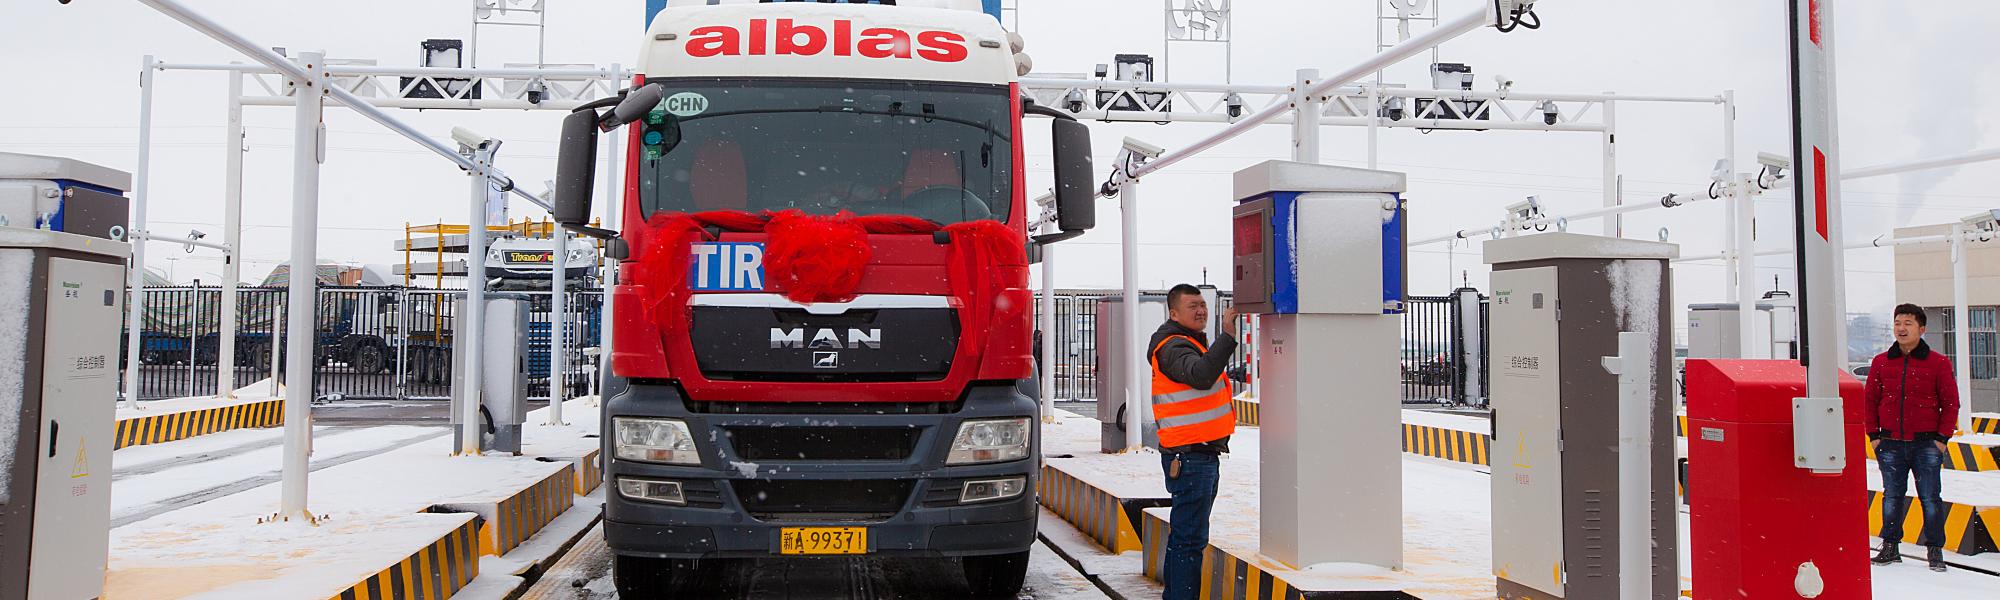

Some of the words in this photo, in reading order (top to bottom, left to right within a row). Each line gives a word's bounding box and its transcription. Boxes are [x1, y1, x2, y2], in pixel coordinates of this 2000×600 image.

[685, 19, 969, 63] alblas
[669, 97, 704, 112] CHN
[690, 244, 763, 289] TIR
[770, 327, 881, 349] MAN
